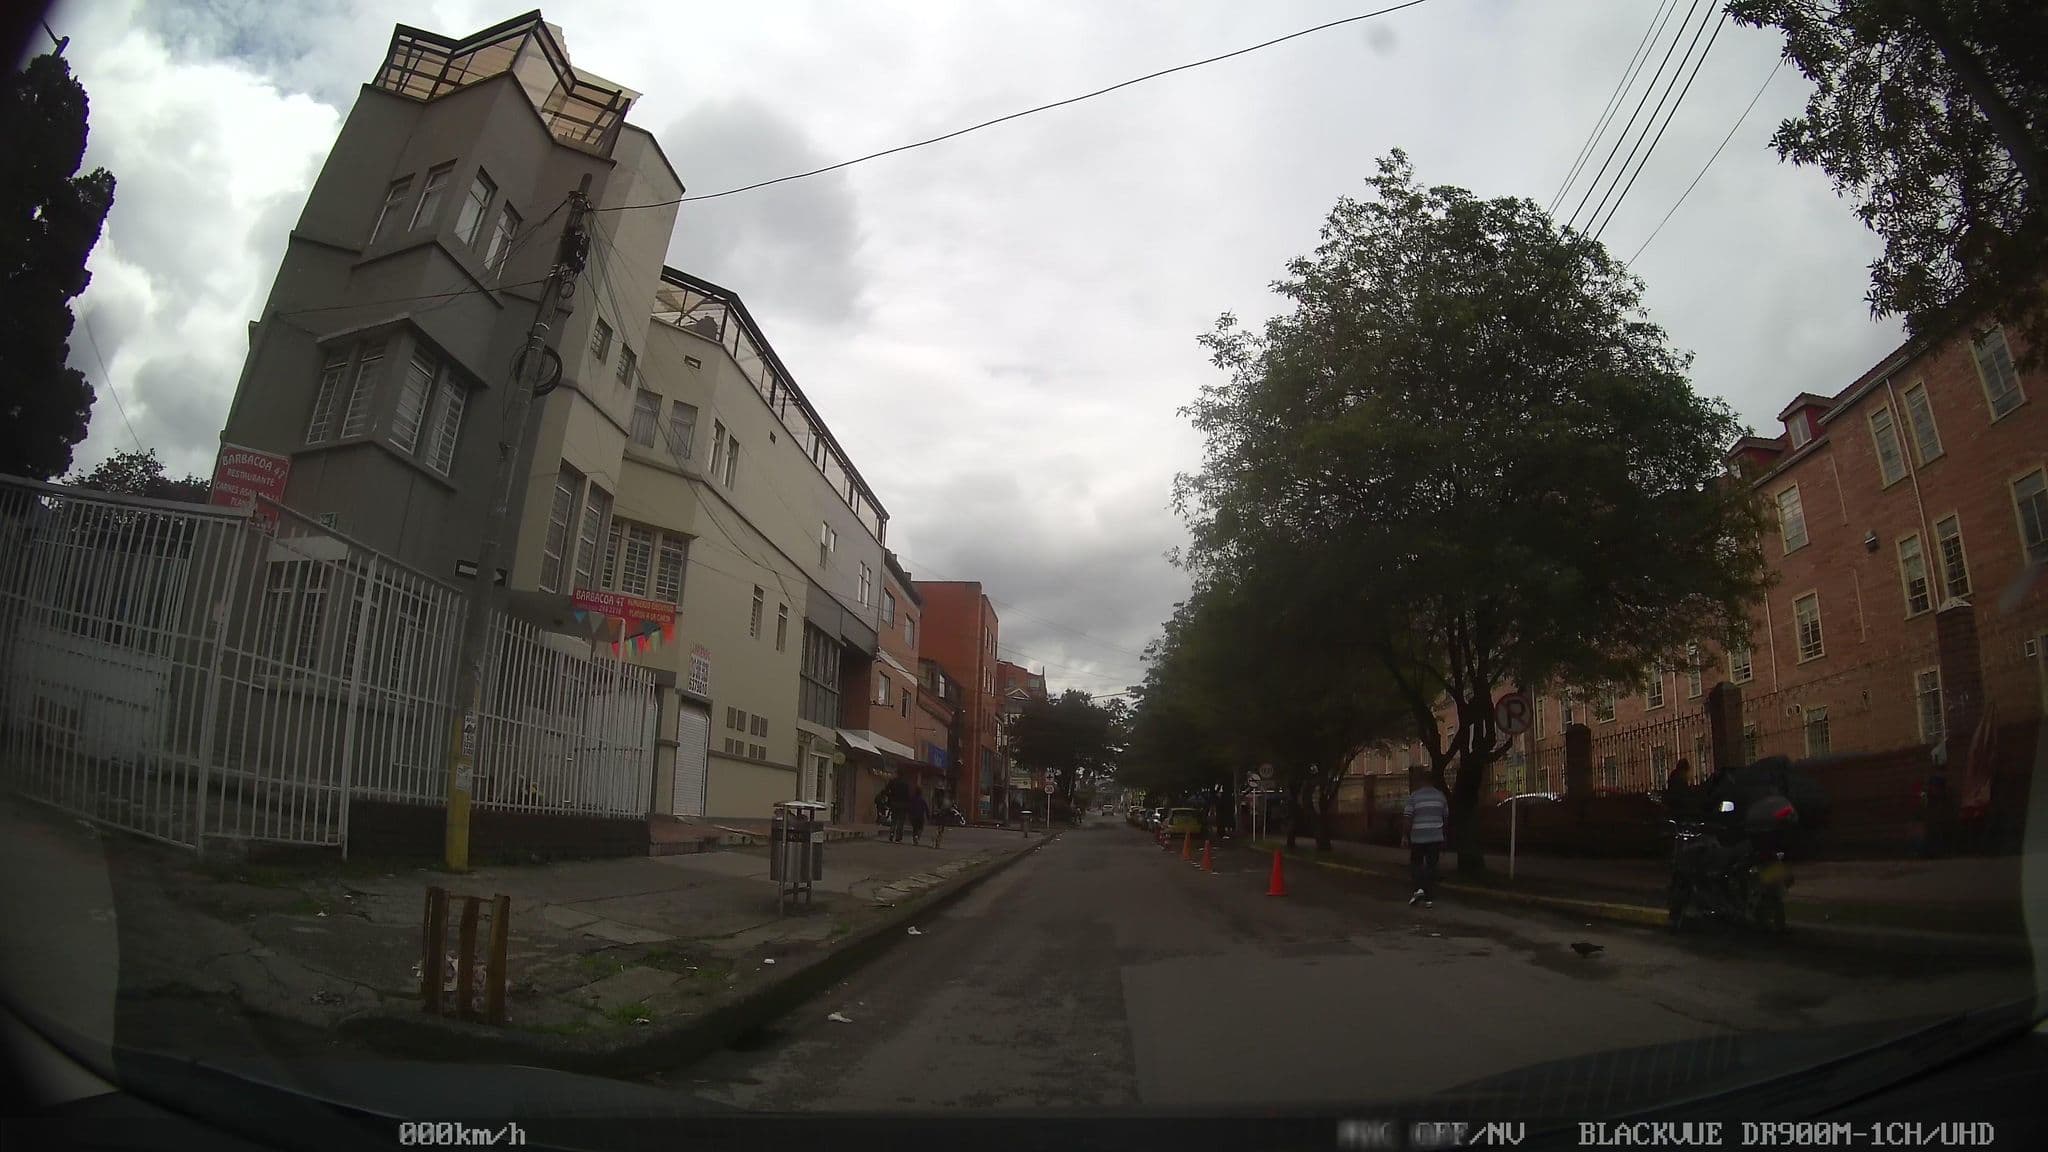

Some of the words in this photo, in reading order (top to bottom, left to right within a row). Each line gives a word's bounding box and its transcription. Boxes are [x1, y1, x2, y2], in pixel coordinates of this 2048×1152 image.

[223, 454, 273, 471] BARBACOA
[227, 468, 275, 487] RESTAURANTE
[576, 590, 614, 606] BARBACOA
[616, 597, 625, 607] 47
